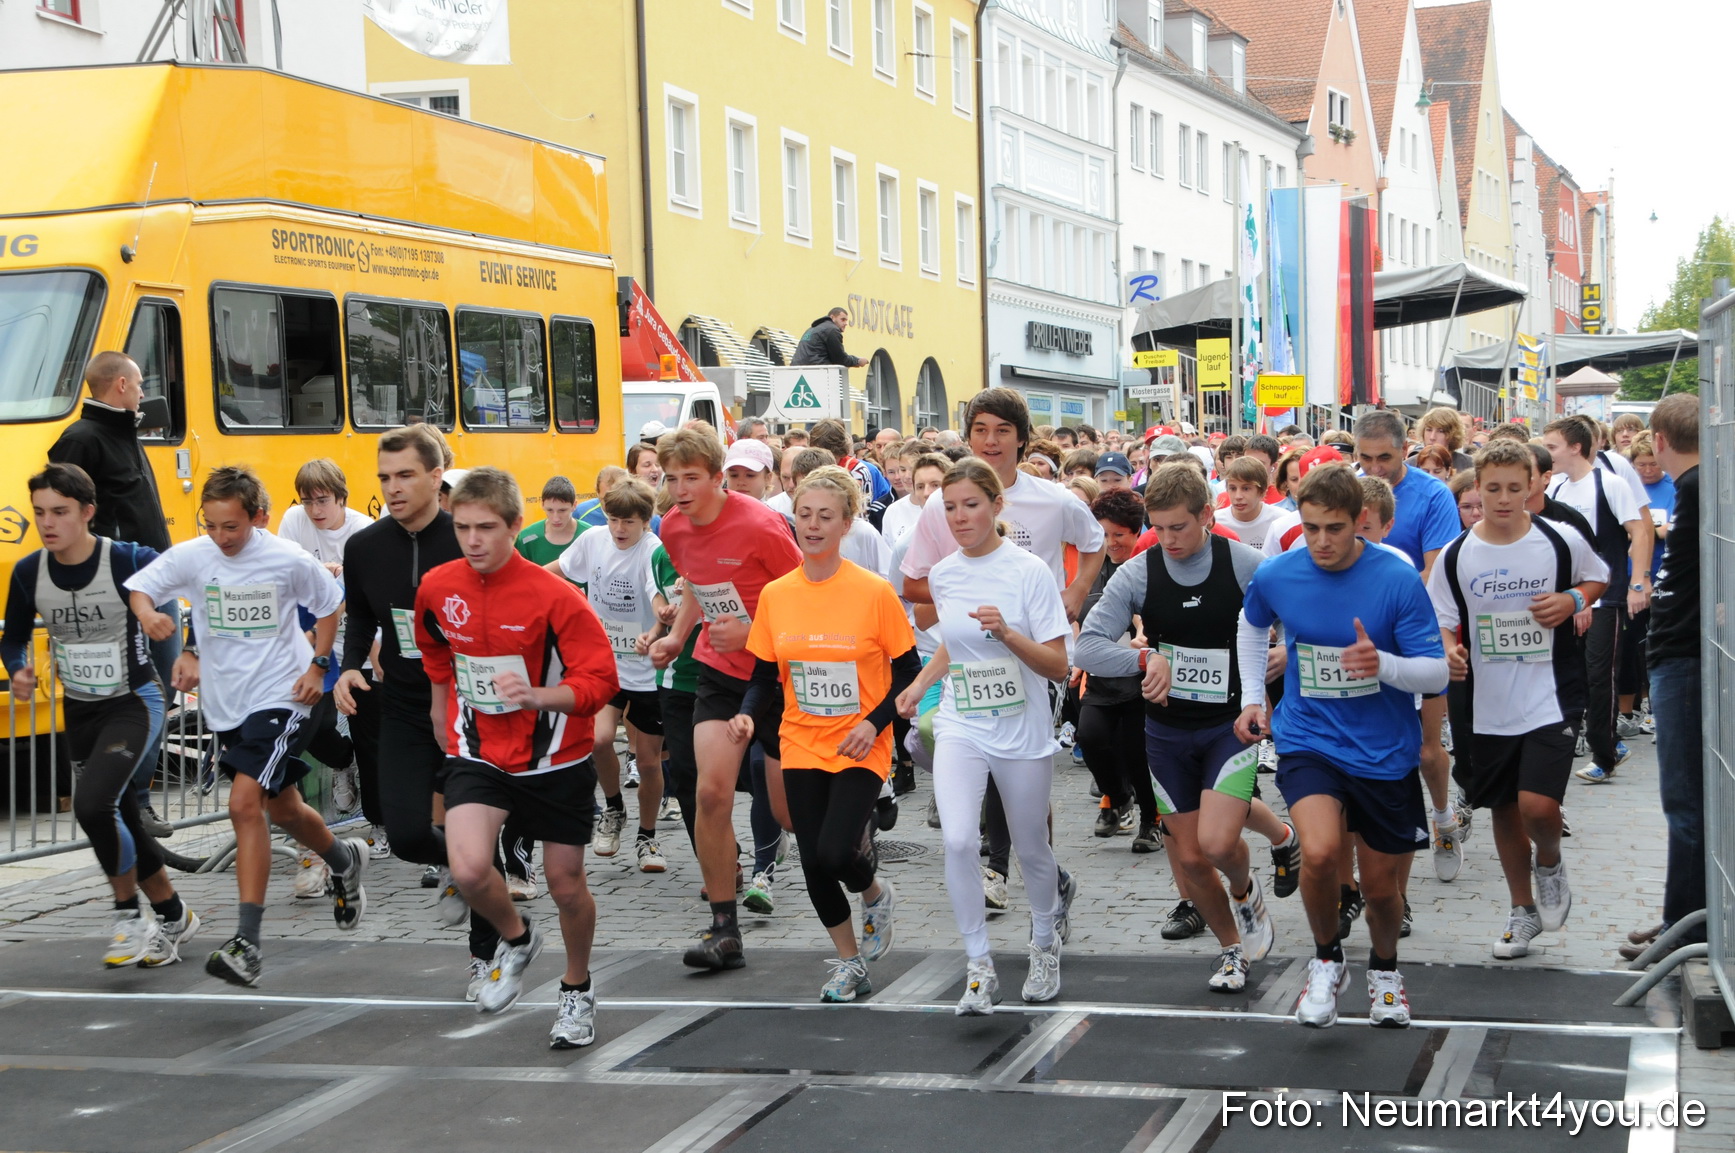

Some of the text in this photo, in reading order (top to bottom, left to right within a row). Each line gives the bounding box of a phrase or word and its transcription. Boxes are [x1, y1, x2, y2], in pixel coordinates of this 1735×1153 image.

[272, 228, 356, 259] SPORTRONIC
[370, 243, 384, 257] Fon:
[420, 249, 445, 264] 1397308
[274, 254, 356, 272] ELECTRONIC SPORTS EQUIPMENT
[479, 260, 557, 291] EVENT SERVICE
[643, 308, 657, 331] Jura
[847, 293, 914, 339] STADTCAFE
[1032, 321, 1093, 355] BRILLEN WEBER
[1198, 352, 1229, 362] Jugend-
[1206, 363, 1221, 371] lauf
[1131, 386, 1171, 395] Klostergasse
[1260, 383, 1301, 392] Schnupper-
[1483, 577, 1548, 594] Fischer
[224, 590, 272, 601] Maximilian
[227, 605, 272, 622] 5028
[704, 599, 739, 614] 5180
[604, 622, 624, 633] Daniel
[1495, 616, 1531, 628] Dominik
[808, 632, 856, 644] ausbildung
[1499, 630, 1543, 647] 5190
[68, 647, 112, 659] Ferdinand
[1176, 651, 1208, 664] Florian
[1316, 651, 1341, 663] Andr
[73, 664, 114, 679] 5070
[470, 661, 495, 675] Björn
[807, 666, 827, 676] Julia
[966, 666, 1007, 678] Veronica
[1176, 667, 1222, 685] 5205
[810, 682, 852, 698] 5106
[972, 681, 1017, 700] 5136
